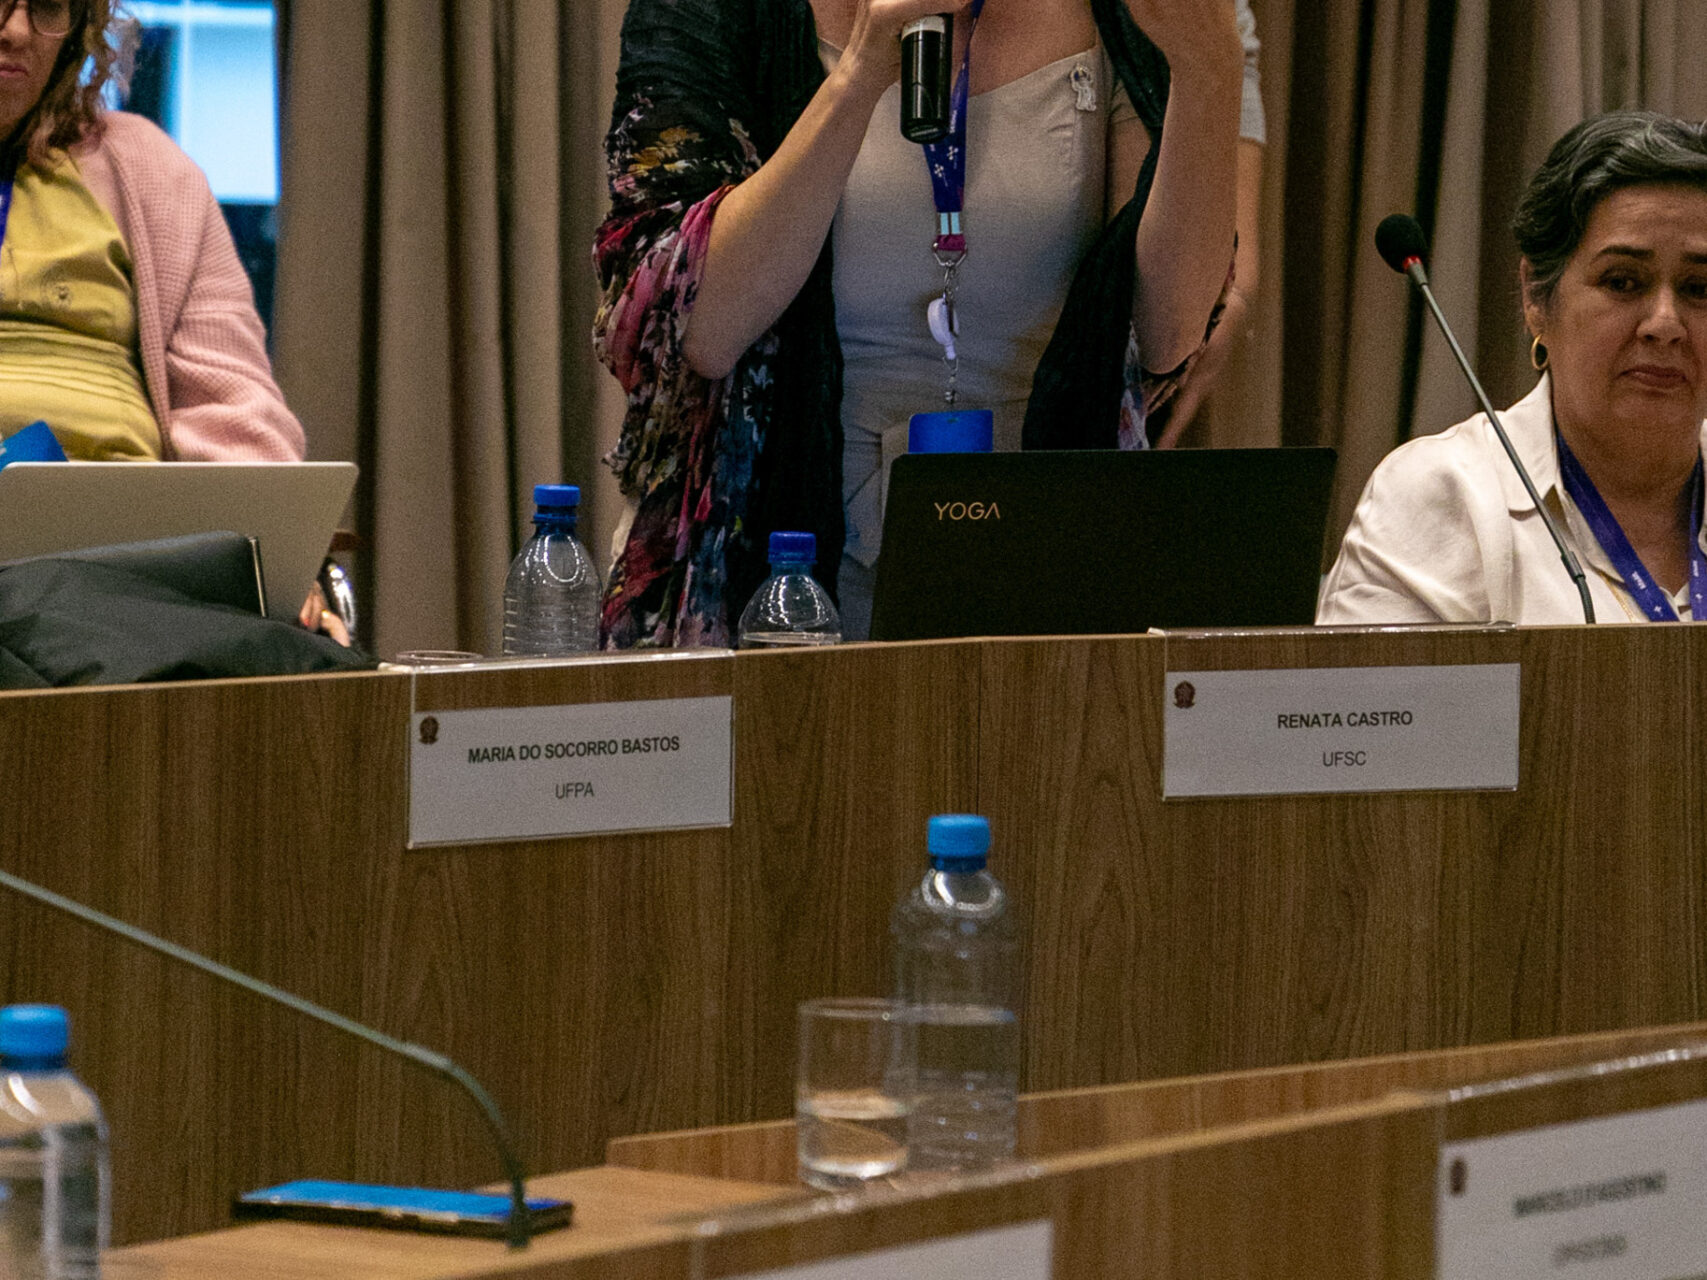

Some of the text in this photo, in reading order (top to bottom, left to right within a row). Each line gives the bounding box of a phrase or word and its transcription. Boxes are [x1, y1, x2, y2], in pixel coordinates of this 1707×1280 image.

[934, 502, 1000, 520] YOGA
[1277, 711, 1413, 729] RENATA CASTRO
[468, 736, 680, 764] MARIA DO SOCORRO BASTOS
[1322, 751, 1367, 767] UFSC
[555, 782, 594, 799] UFPA
